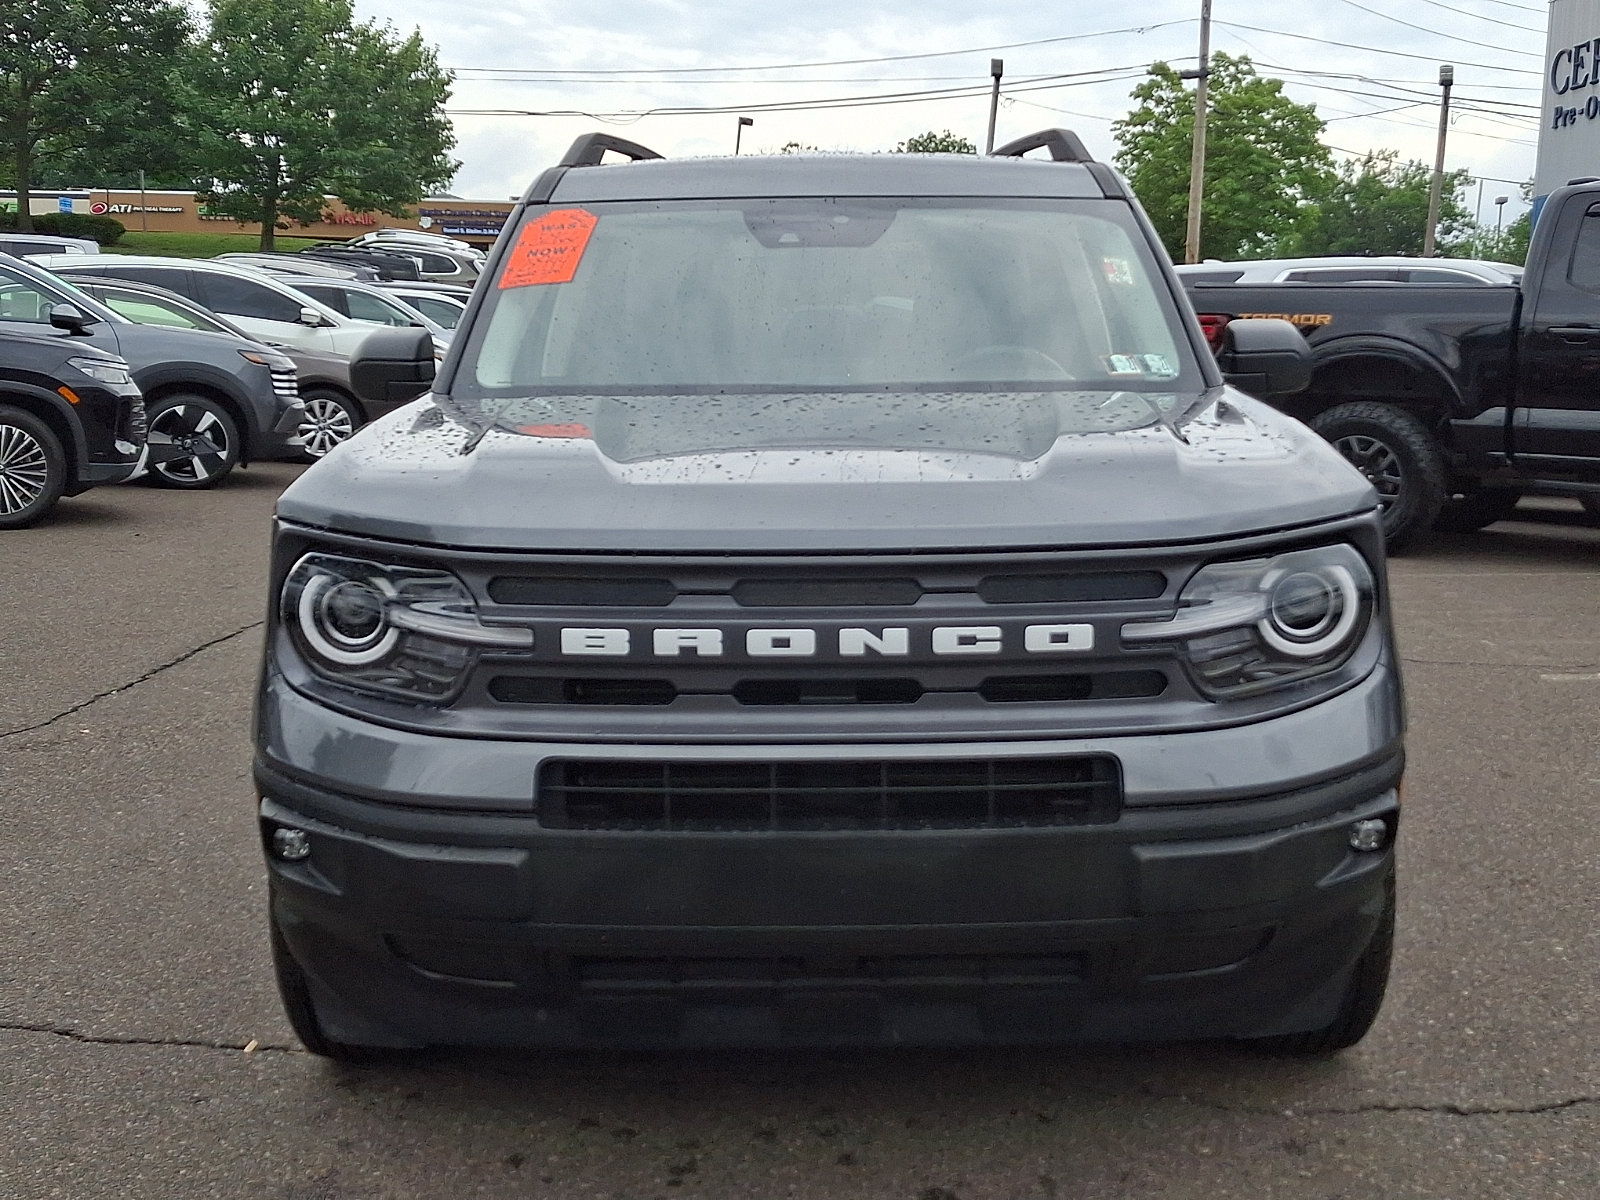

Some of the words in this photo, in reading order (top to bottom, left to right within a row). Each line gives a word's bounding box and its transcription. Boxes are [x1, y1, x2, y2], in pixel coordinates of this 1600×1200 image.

[1552, 95, 1600, 129] Pre-O
[108, 204, 132, 213] ATI
[560, 624, 1094, 656] BRONCO
